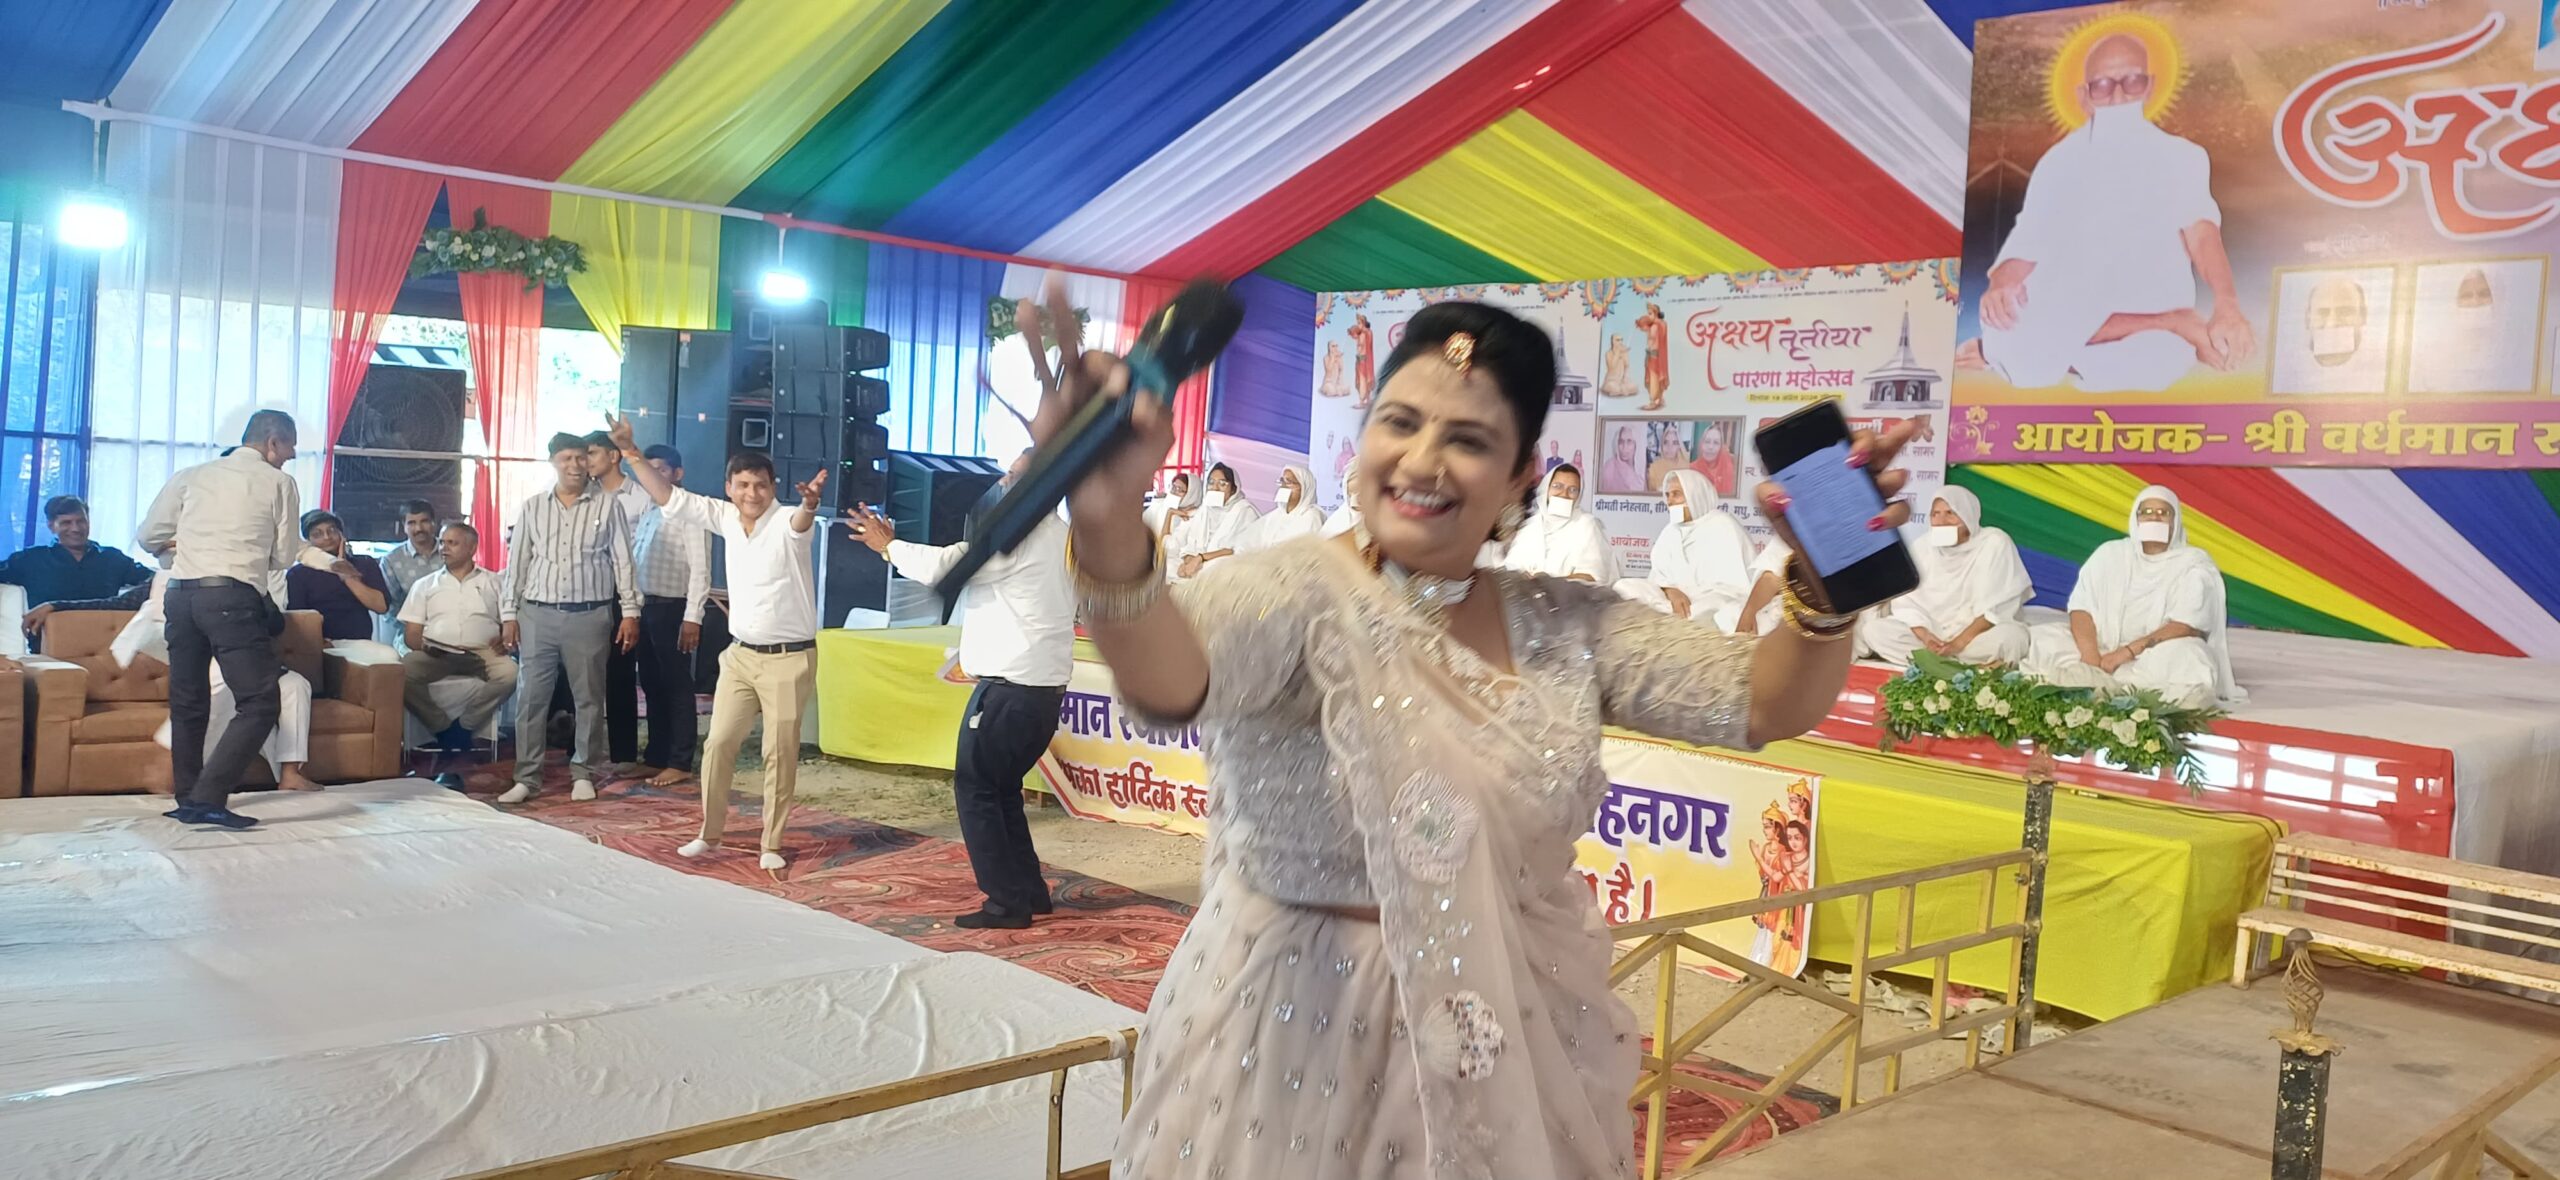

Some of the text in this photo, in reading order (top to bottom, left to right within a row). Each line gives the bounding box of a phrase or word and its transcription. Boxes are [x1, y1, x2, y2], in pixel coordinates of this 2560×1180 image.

[1686, 306, 1872, 390] अक्षय तृतीया
[1732, 363, 1855, 391] पारणा महोत्सव
[2244, 408, 2309, 455] श्री
[2322, 408, 2520, 456] वर्धमान
[1595, 499, 1618, 512] श्रीमती
[1610, 534, 1650, 548] आयोजक
[1060, 691, 1112, 738] मान
[1598, 783, 1729, 858] हनगर
[1104, 761, 1177, 812] हार्दिक
